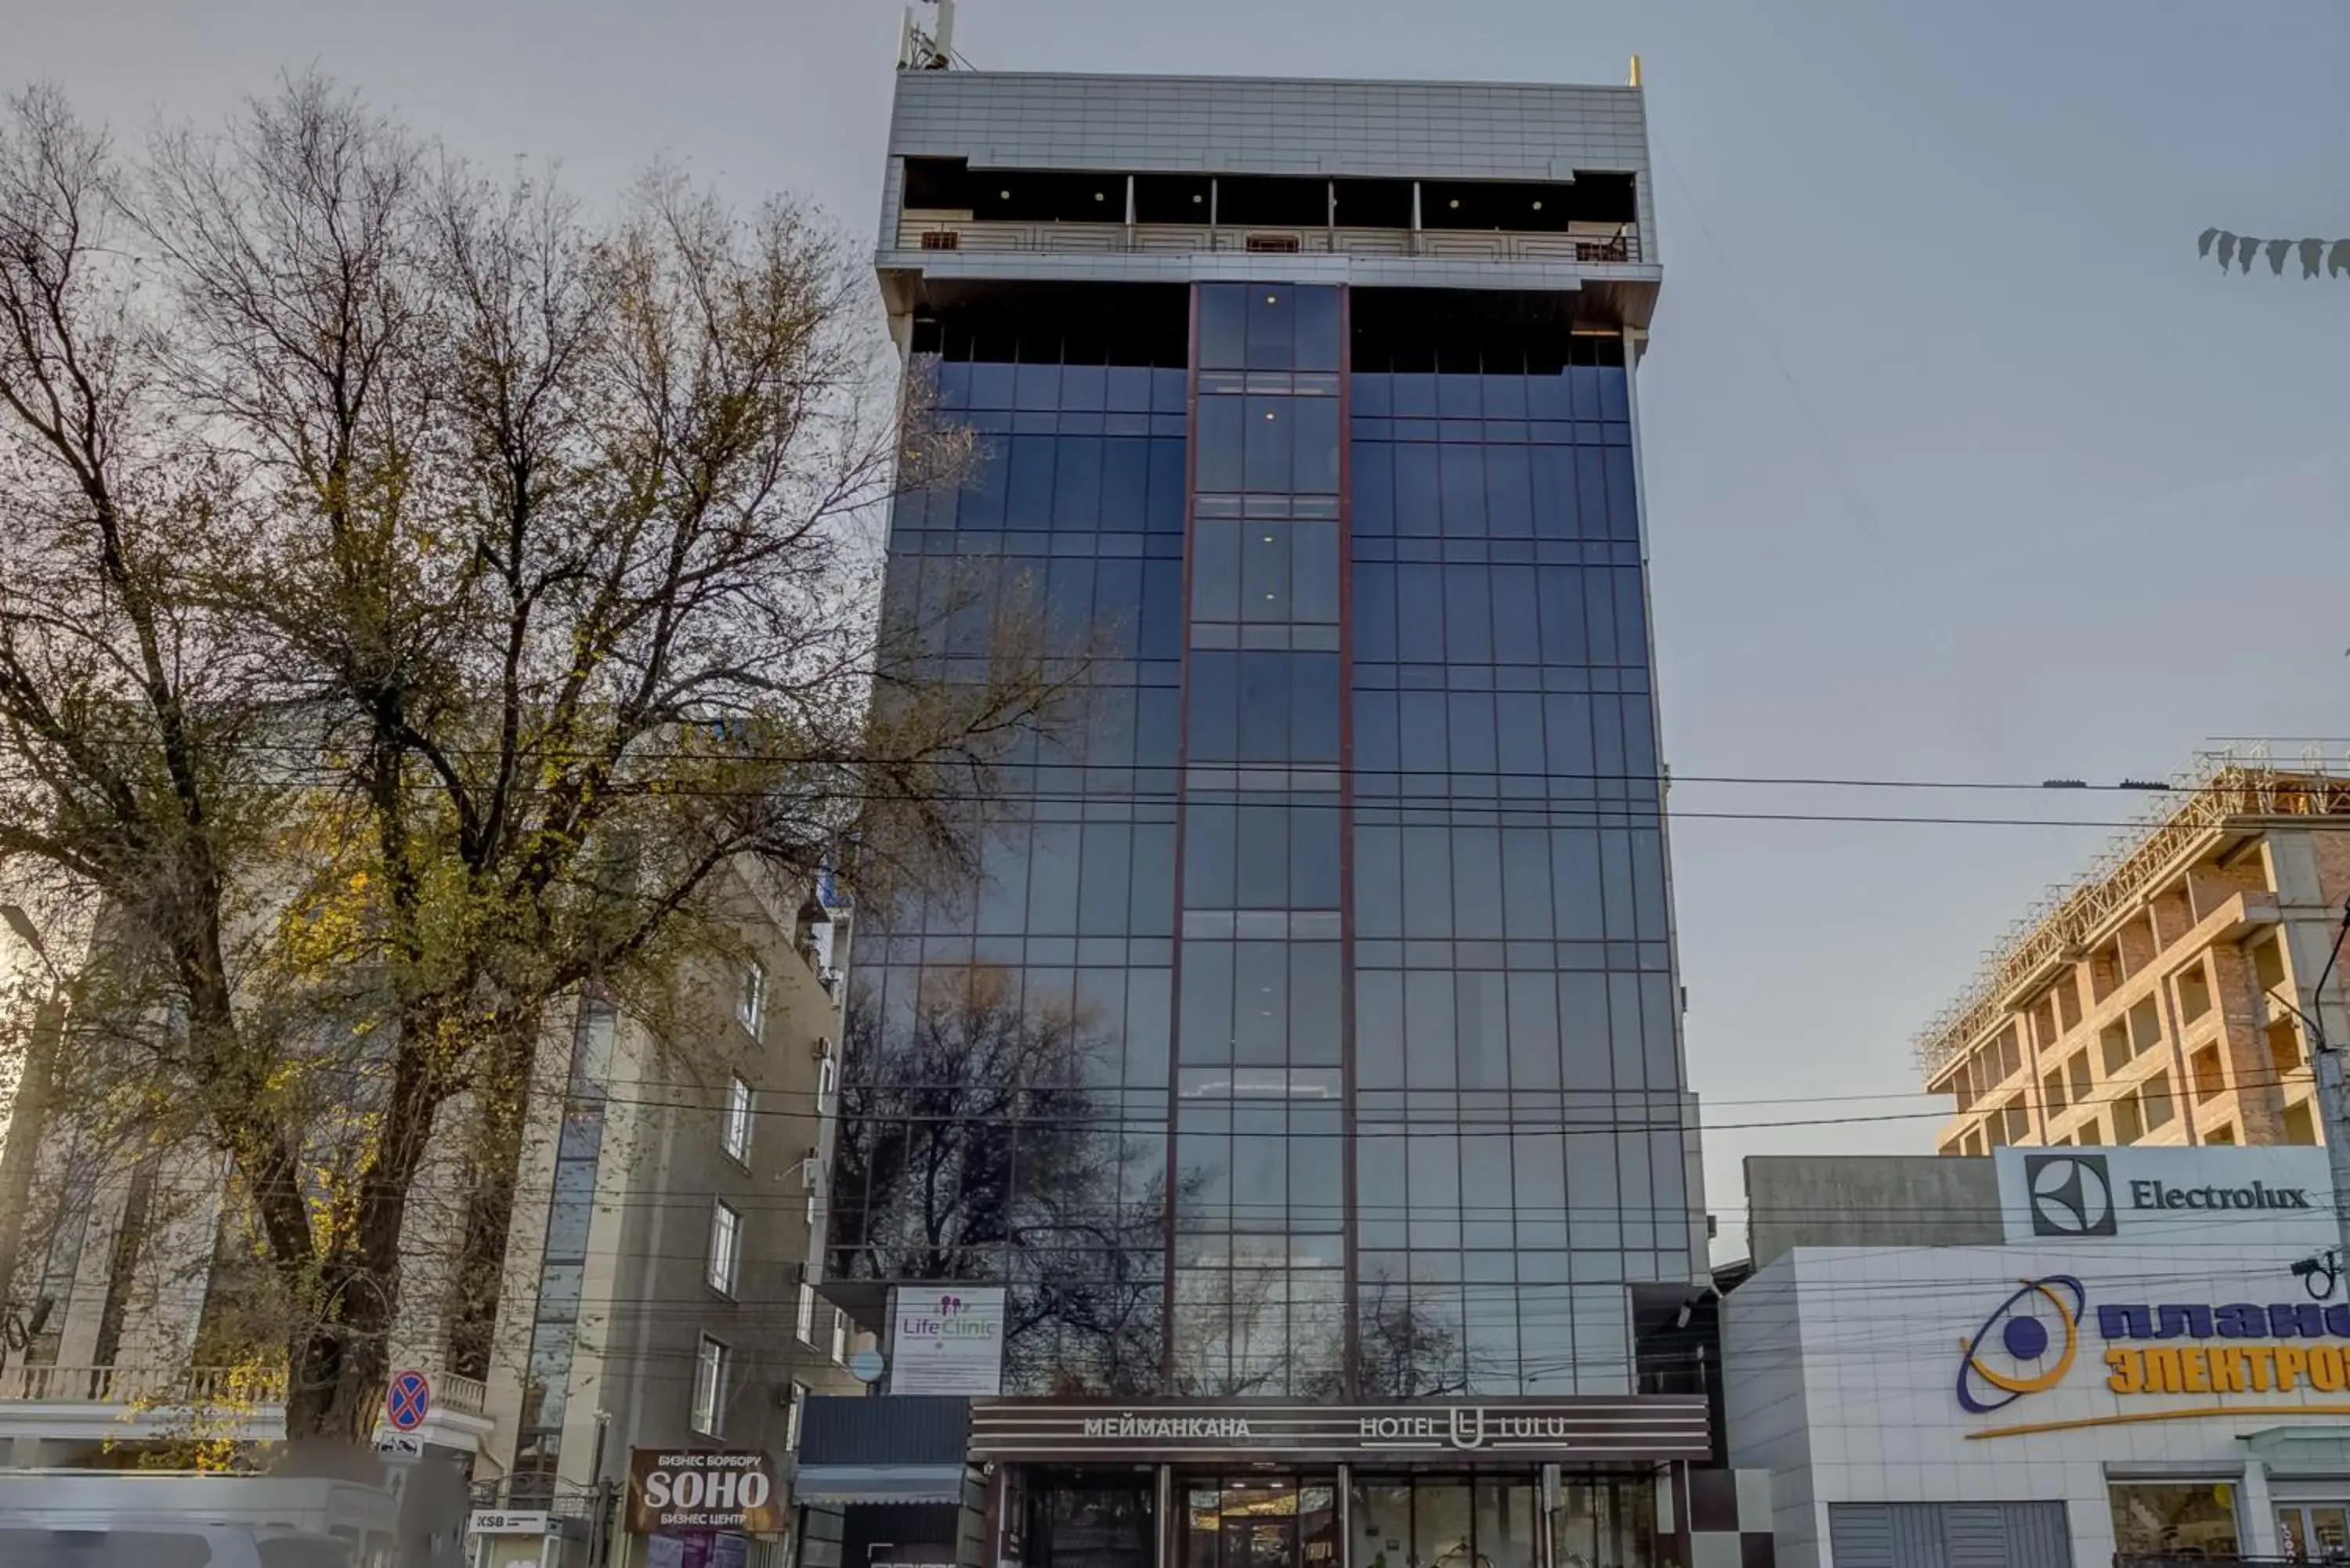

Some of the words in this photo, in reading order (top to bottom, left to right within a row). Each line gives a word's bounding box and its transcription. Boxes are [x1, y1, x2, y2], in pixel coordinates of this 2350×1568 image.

[2129, 1180, 2311, 1209] Electrolux
[2104, 1343, 2350, 1394] ЭЛЕКТРО
[1083, 1412, 1251, 1438] МЕЙМАНКАНА
[1359, 1416, 1440, 1438] HOTEL
[1499, 1416, 1565, 1438] LULU
[658, 1454, 704, 1467] БИЗНЕС
[707, 1455, 762, 1468] БОРБОРУ
[643, 1470, 770, 1508] SOHO
[660, 1513, 708, 1525] БИЗНЕС
[709, 1514, 747, 1526] ЦЕНТР
